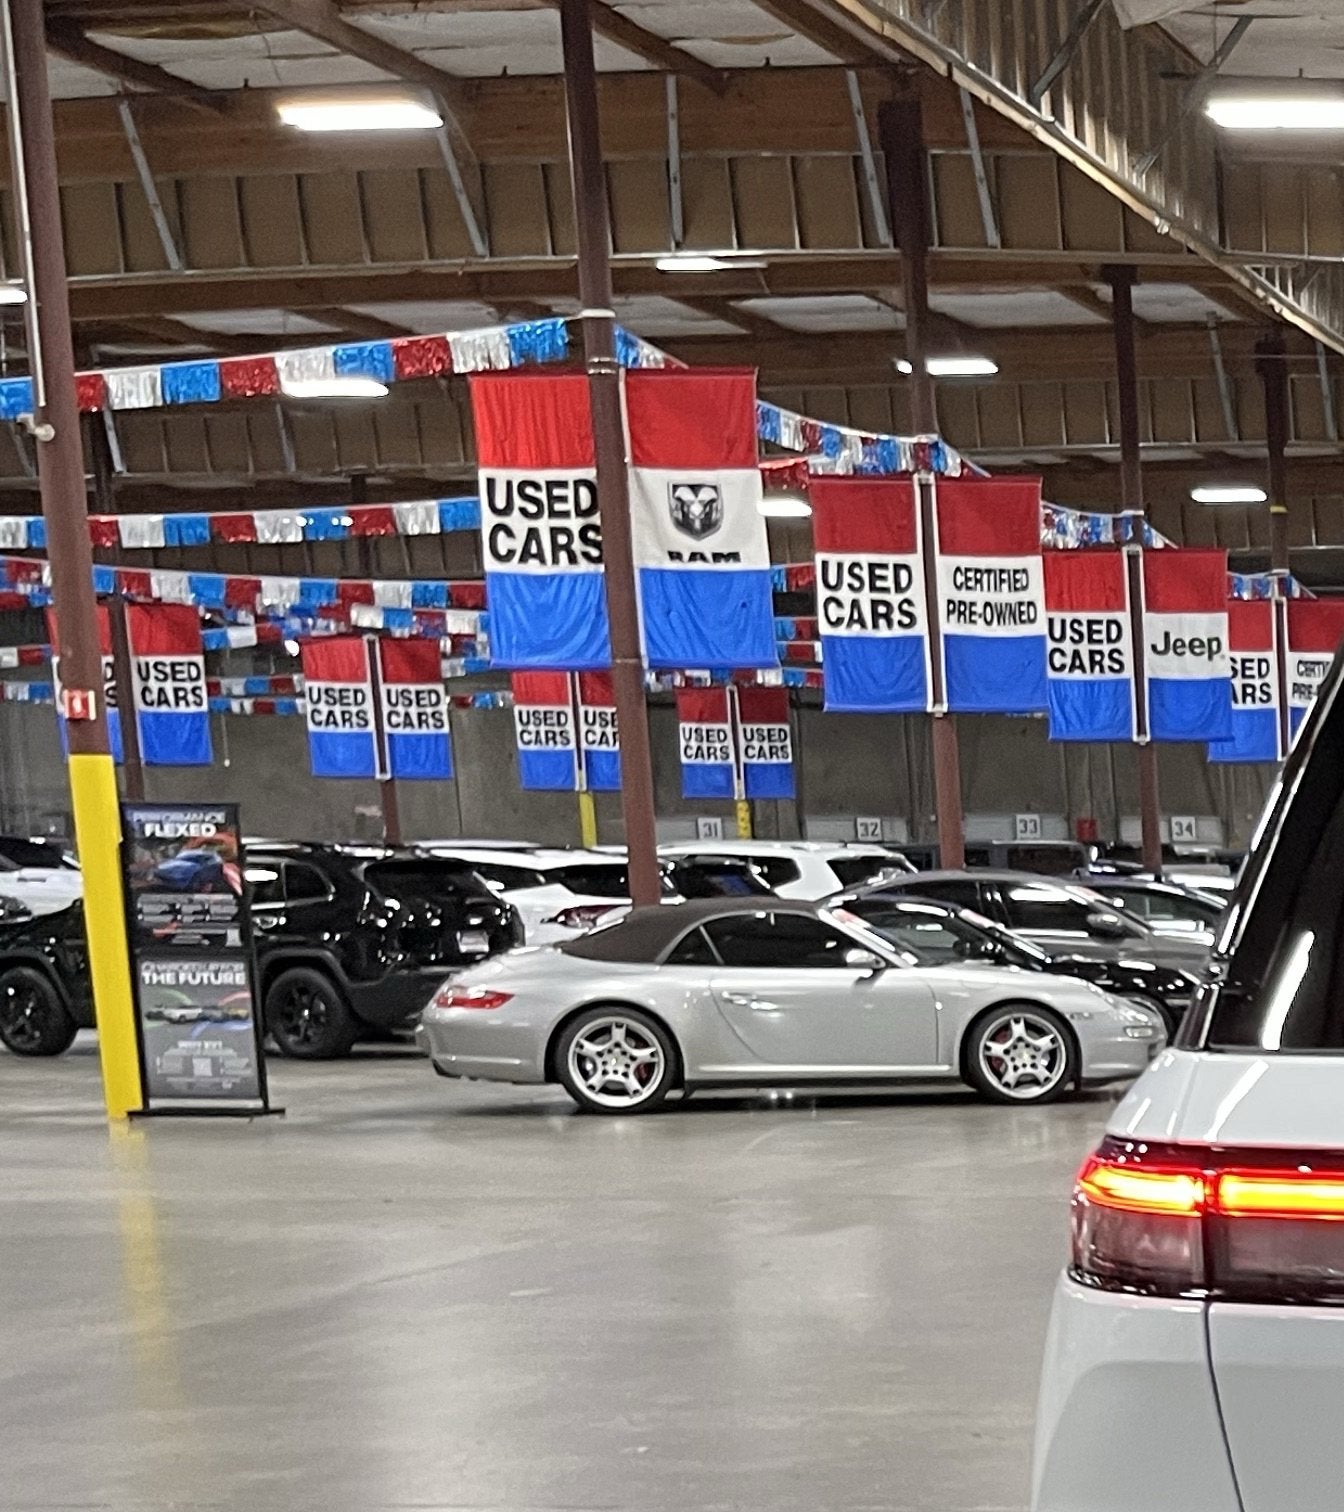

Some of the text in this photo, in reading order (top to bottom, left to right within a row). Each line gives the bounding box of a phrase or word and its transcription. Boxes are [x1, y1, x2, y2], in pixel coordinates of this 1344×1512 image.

[486, 478, 600, 519] USED
[489, 523, 601, 565] CARS
[667, 551, 742, 563] RAM
[821, 560, 913, 594] USED
[953, 566, 1030, 592] CERTIFIED
[823, 596, 917, 630] CARS
[946, 599, 1038, 626] PRE-OWNED
[1048, 618, 1123, 645] USED
[1151, 631, 1222, 661] Jeep
[1049, 648, 1125, 674] CARS
[1230, 657, 1270, 679] SED
[137, 661, 200, 682] USED
[141, 686, 204, 708] CARS
[308, 686, 366, 707] USED
[386, 688, 441, 708] USED
[310, 708, 369, 728] CARS
[387, 710, 445, 729] CARS
[518, 710, 568, 728] USED
[519, 729, 570, 746] CARS
[682, 727, 728, 743] USED
[743, 727, 788, 743] USED
[683, 745, 730, 760] CARS
[744, 745, 789, 760] CARS
[144, 822, 217, 837] FLEXED
[702, 822, 718, 837] 31
[860, 822, 879, 837] 32
[1019, 819, 1038, 834] 33
[1174, 821, 1193, 836] 34
[142, 971, 247, 986] THE FUTURE
